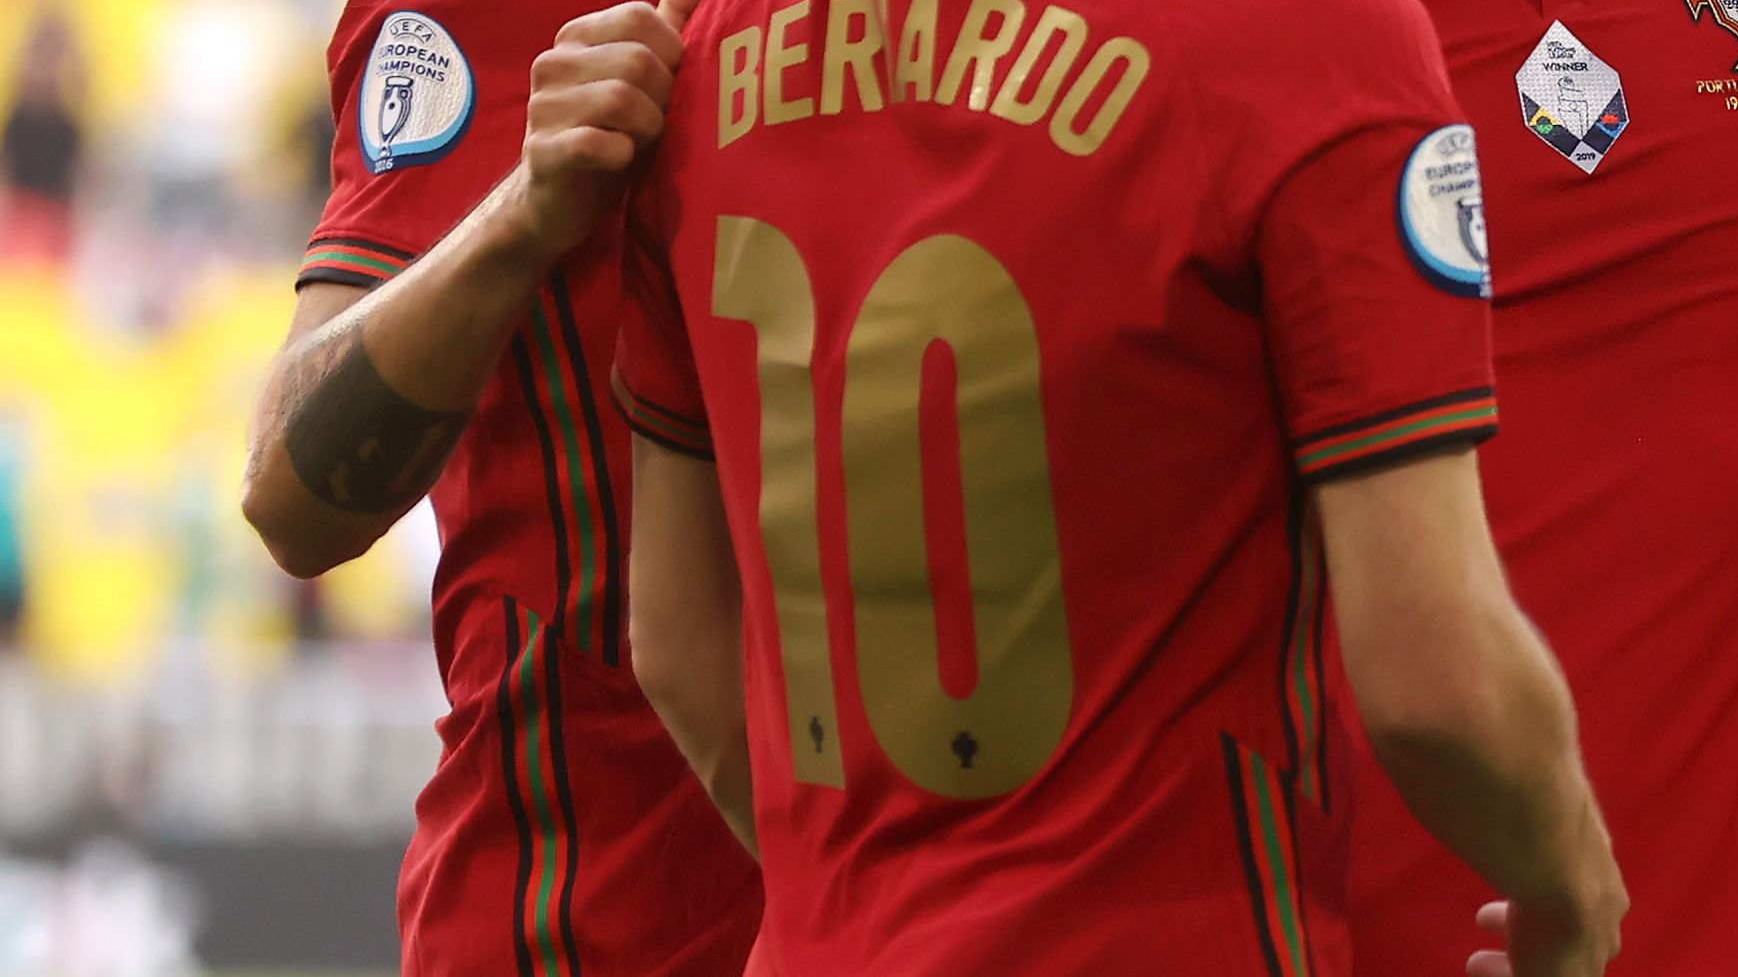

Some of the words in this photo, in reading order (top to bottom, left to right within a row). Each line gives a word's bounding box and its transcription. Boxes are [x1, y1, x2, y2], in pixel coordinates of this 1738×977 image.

[389, 22, 433, 42] UEFA
[1542, 62, 1589, 72] WINNER
[1725, 96, 1738, 111] 19
[1575, 153, 1596, 161] 2019
[711, 214, 1075, 801] 10
